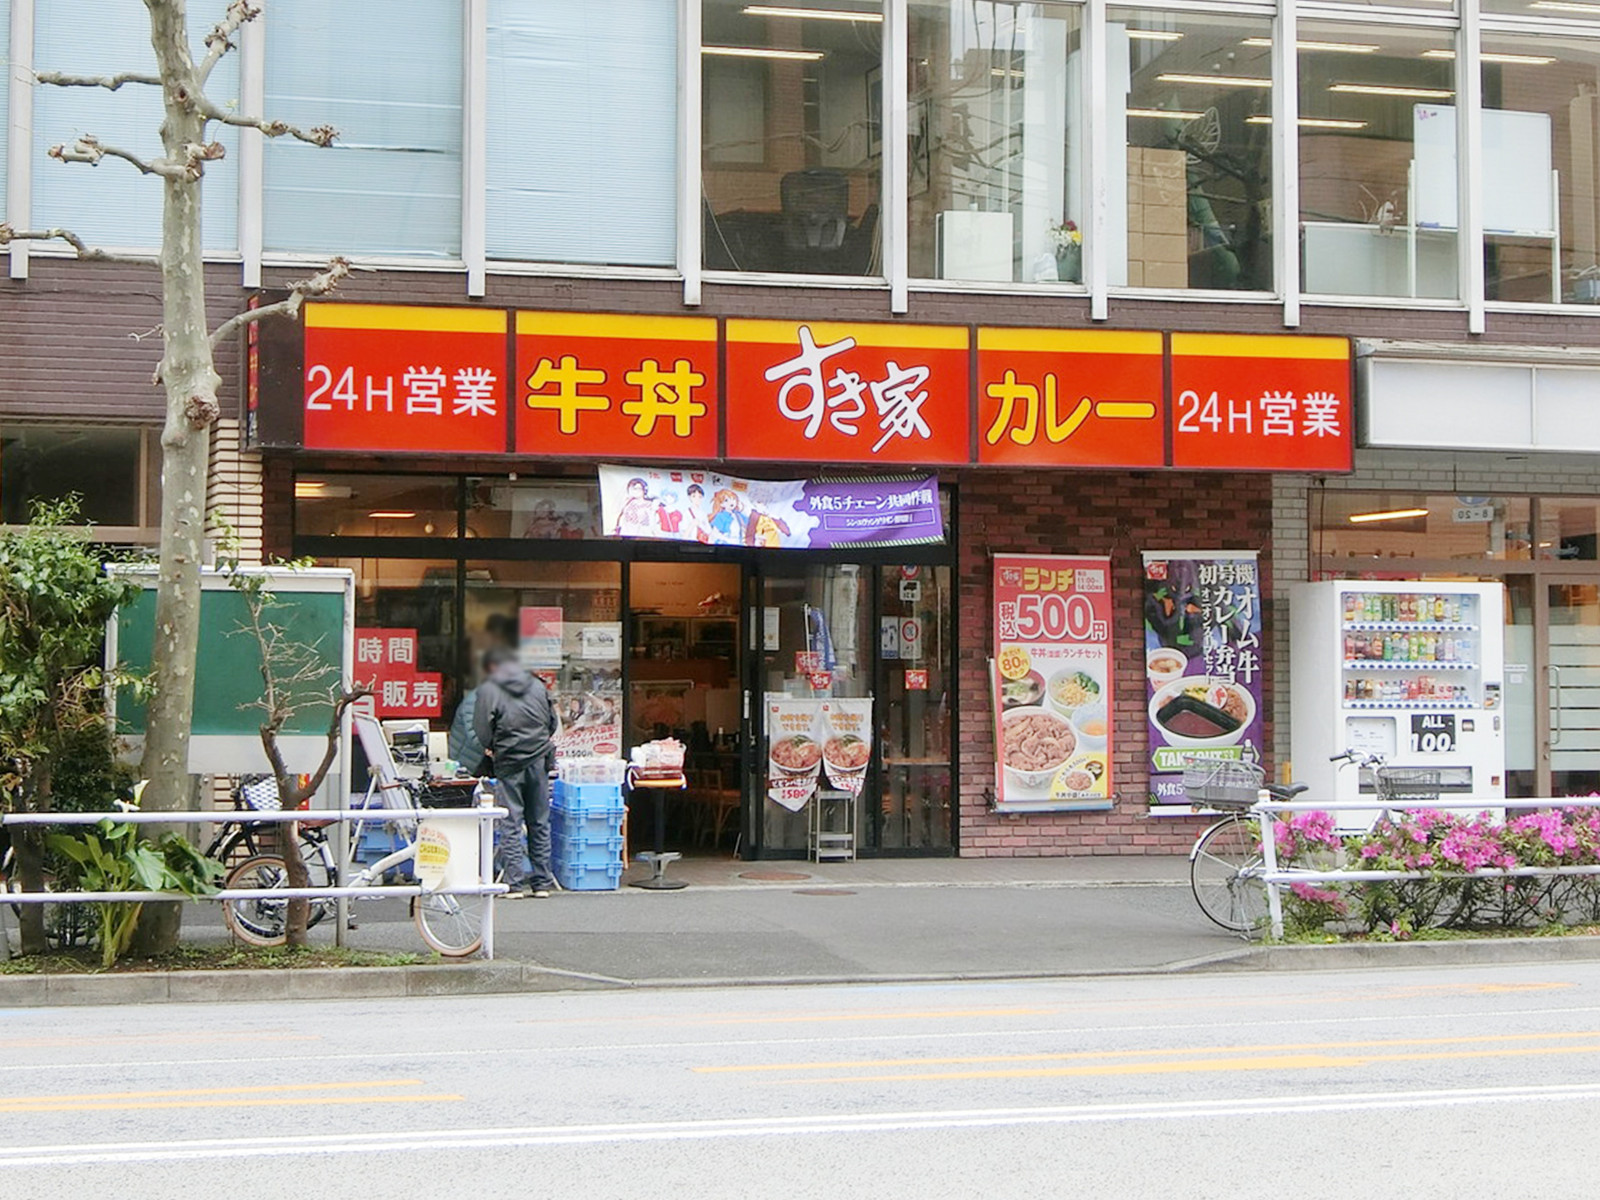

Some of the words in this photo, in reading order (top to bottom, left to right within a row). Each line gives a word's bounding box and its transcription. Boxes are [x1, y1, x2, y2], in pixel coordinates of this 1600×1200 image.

[306, 365, 498, 417] 24H営業
[526, 354, 708, 437] 牛丼
[765, 326, 932, 454] すき家
[985, 369, 1157, 446] カレー
[1177, 390, 1342, 438] 24H営業
[1024, 567, 1075, 592] ランチ
[1199, 564, 1256, 586] 初号機
[1000, 602, 1016, 638] 税込
[1213, 585, 1238, 686] カレー弁当
[1235, 586, 1261, 685] オム牛
[358, 637, 414, 664] 時間
[382, 681, 439, 708] 販売
[1422, 715, 1446, 728] ALL
